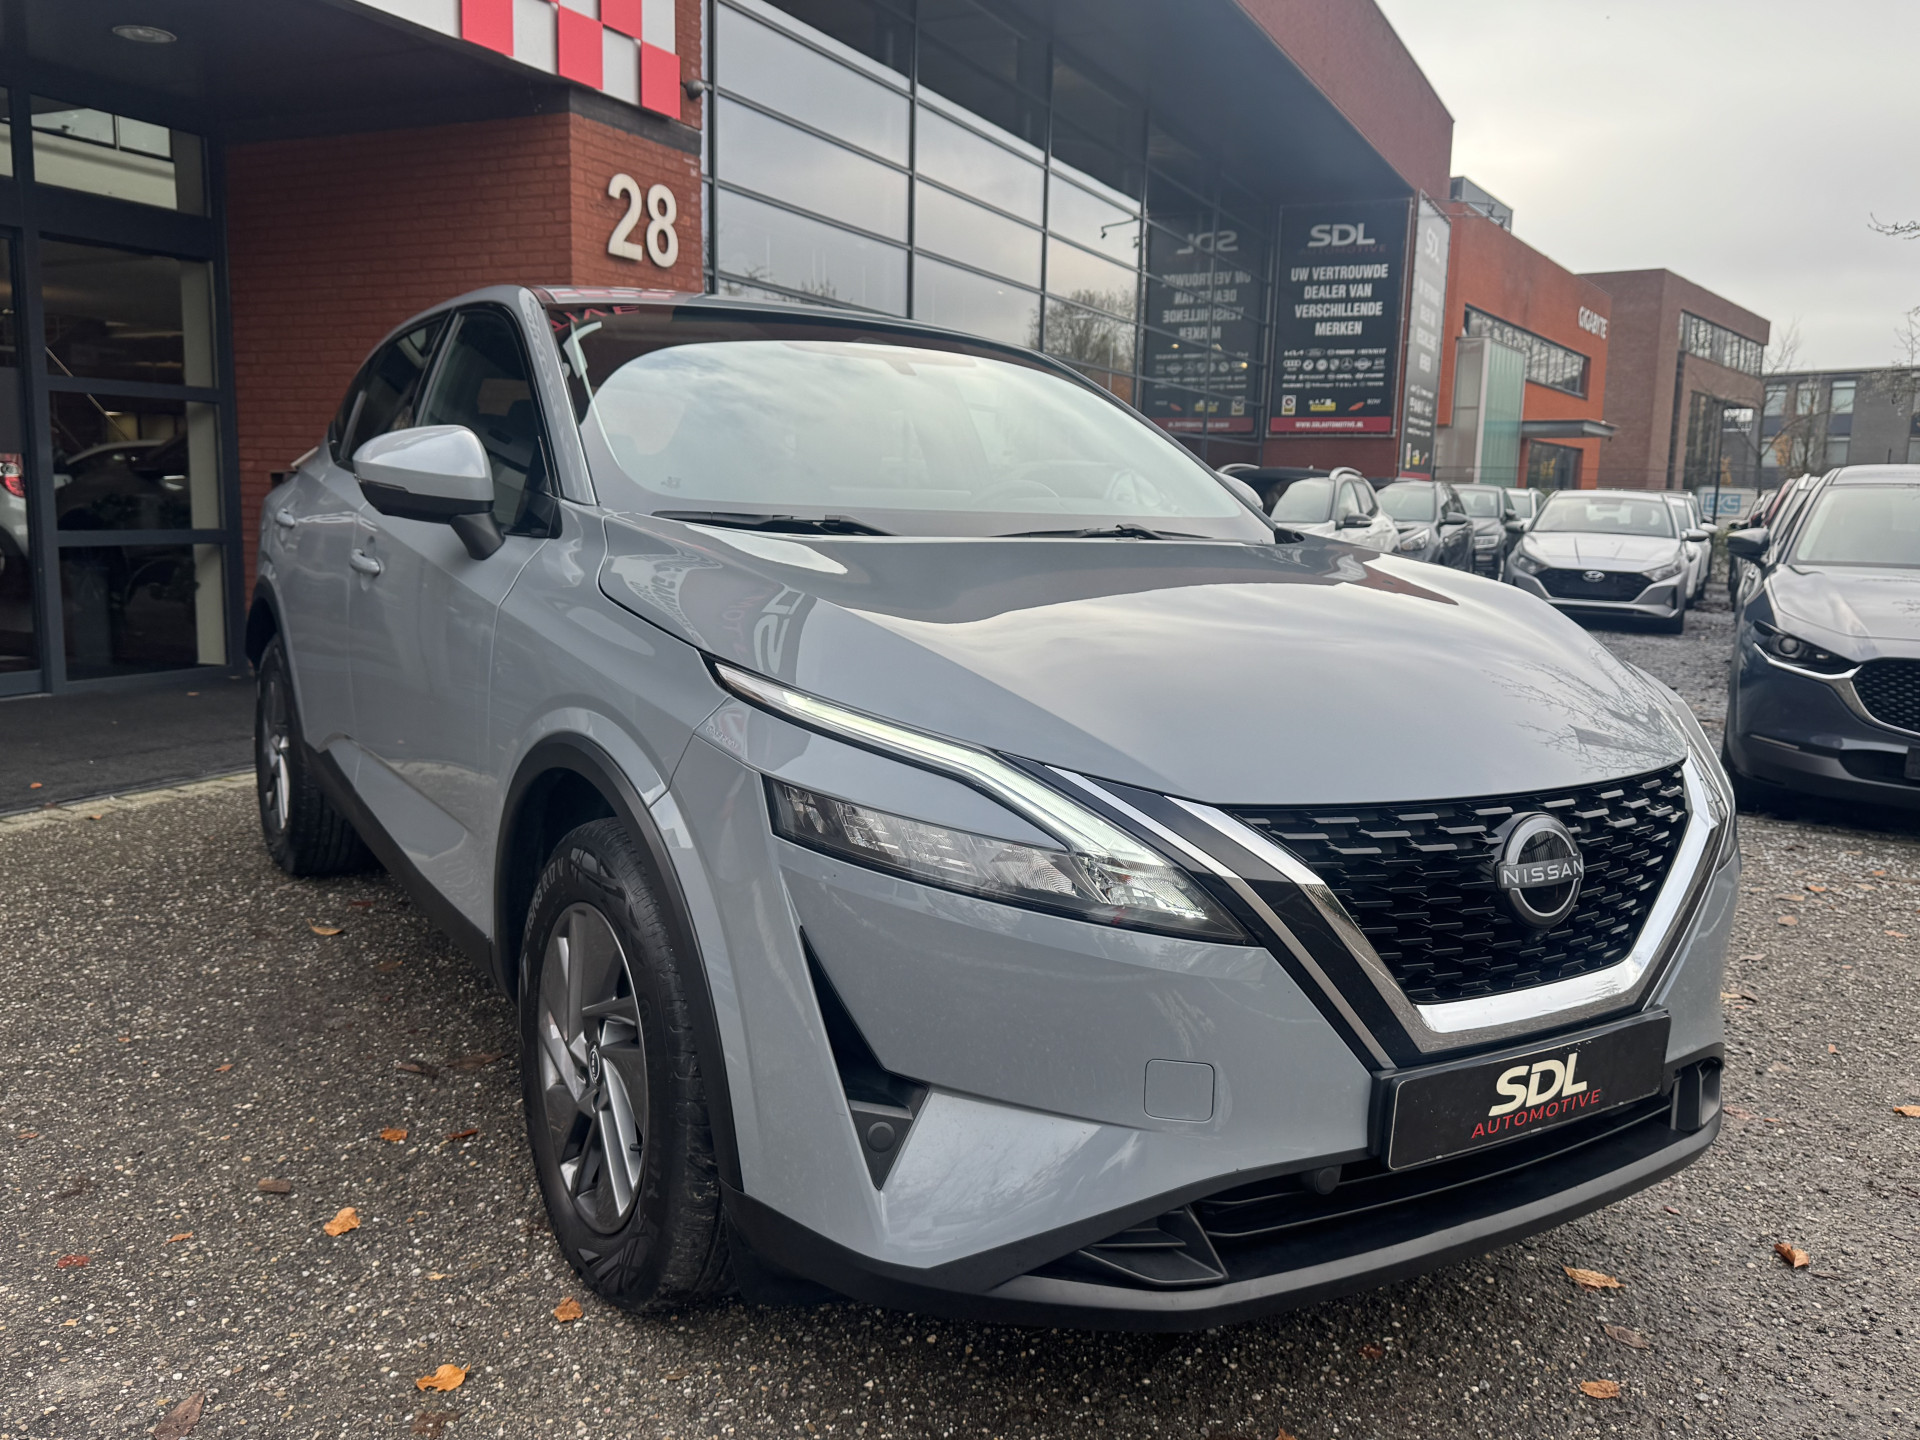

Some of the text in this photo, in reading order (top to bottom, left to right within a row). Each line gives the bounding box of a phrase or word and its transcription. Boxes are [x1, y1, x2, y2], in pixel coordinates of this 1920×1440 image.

[607, 173, 679, 268] 28
[1306, 222, 1376, 248] SDL
[1290, 263, 1389, 282] UW VERTROUWDE
[1304, 283, 1373, 299] DEALER VAN
[1294, 301, 1383, 319] VERSCHILLENDE
[1314, 320, 1363, 336] MERKEN
[1503, 860, 1583, 885] NISSAN
[1488, 1052, 1588, 1117] SDL
[1471, 1088, 1601, 1139] AUTOMOTIVE
